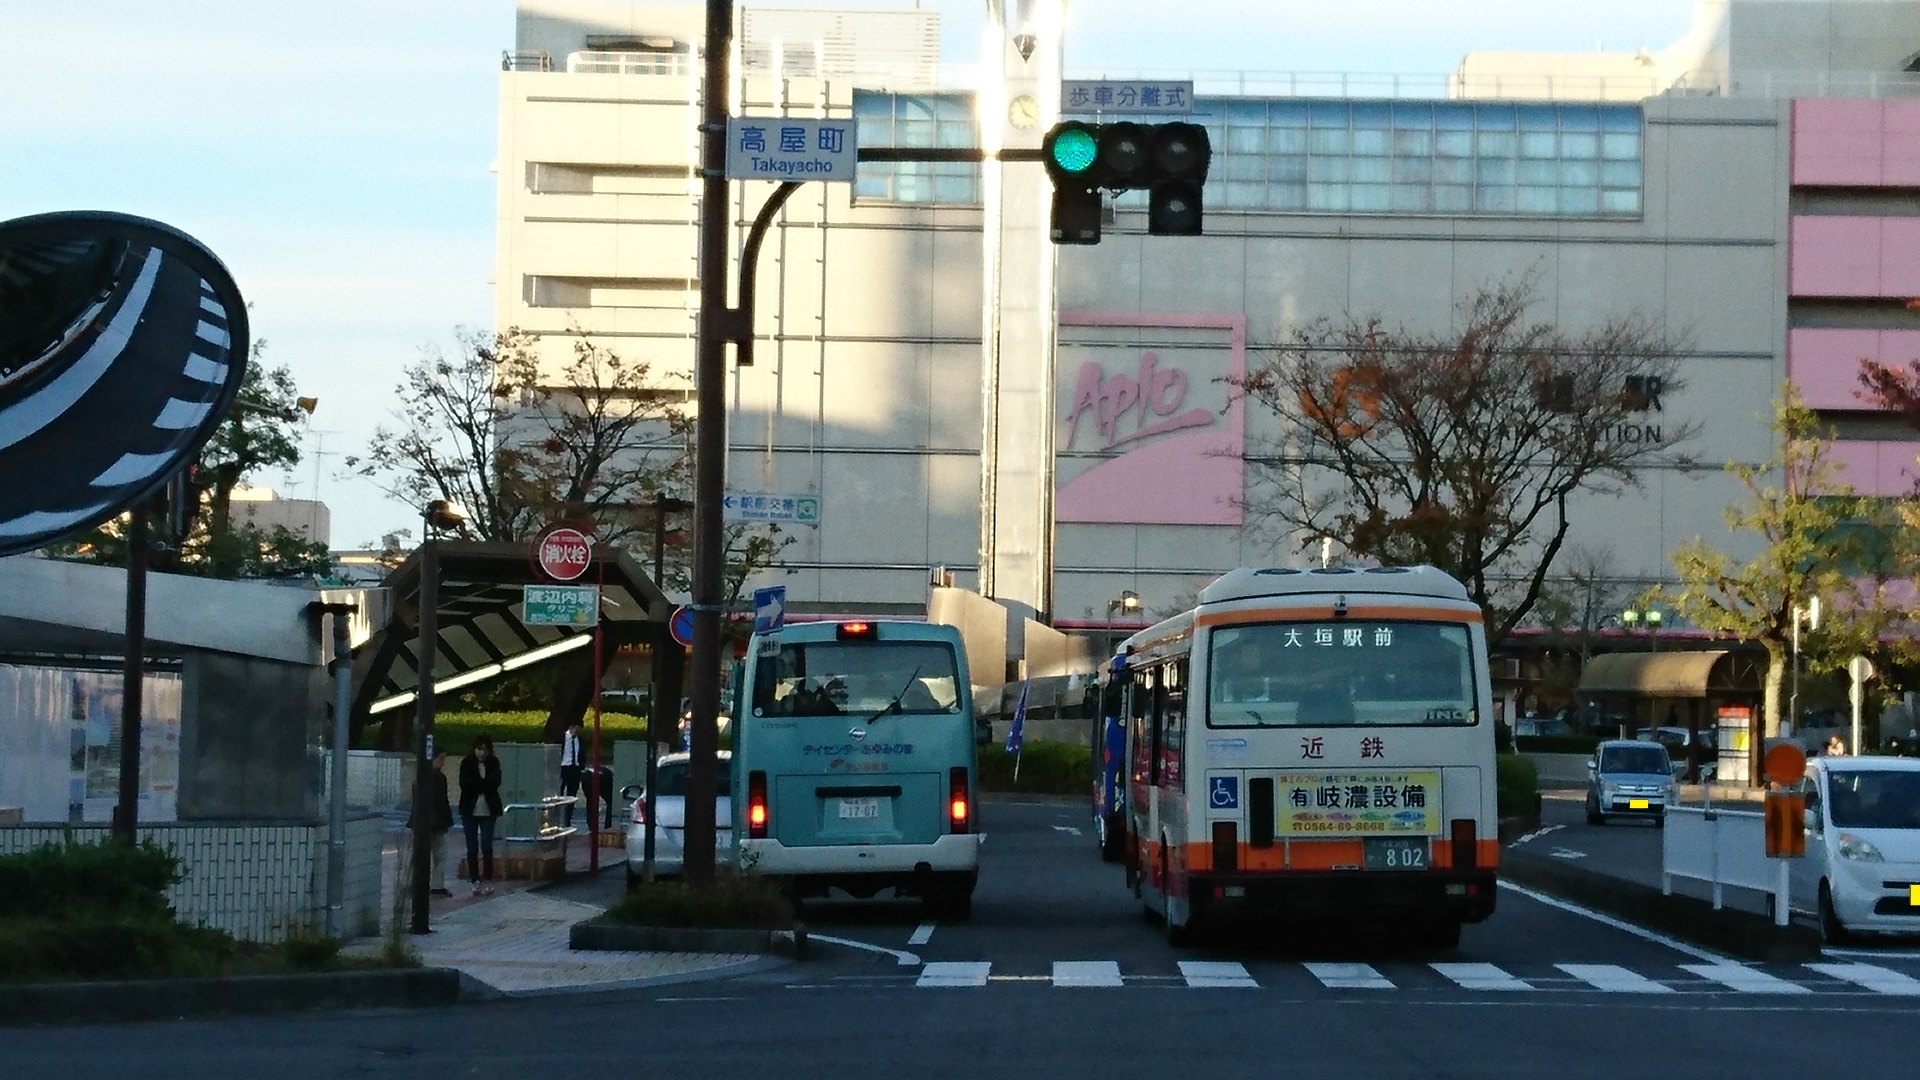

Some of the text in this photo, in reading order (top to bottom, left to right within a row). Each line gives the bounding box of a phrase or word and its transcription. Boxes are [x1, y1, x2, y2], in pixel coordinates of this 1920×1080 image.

[1069, 85, 1185, 107] 歩車分離式
[740, 125, 845, 153] 高屋町
[751, 157, 833, 176] Takayacho
[1064, 350, 1189, 450] Apio
[545, 543, 587, 565] 消火栓
[1284, 627, 1394, 648] 大垣駅前
[1301, 736, 1384, 759] 近鉄
